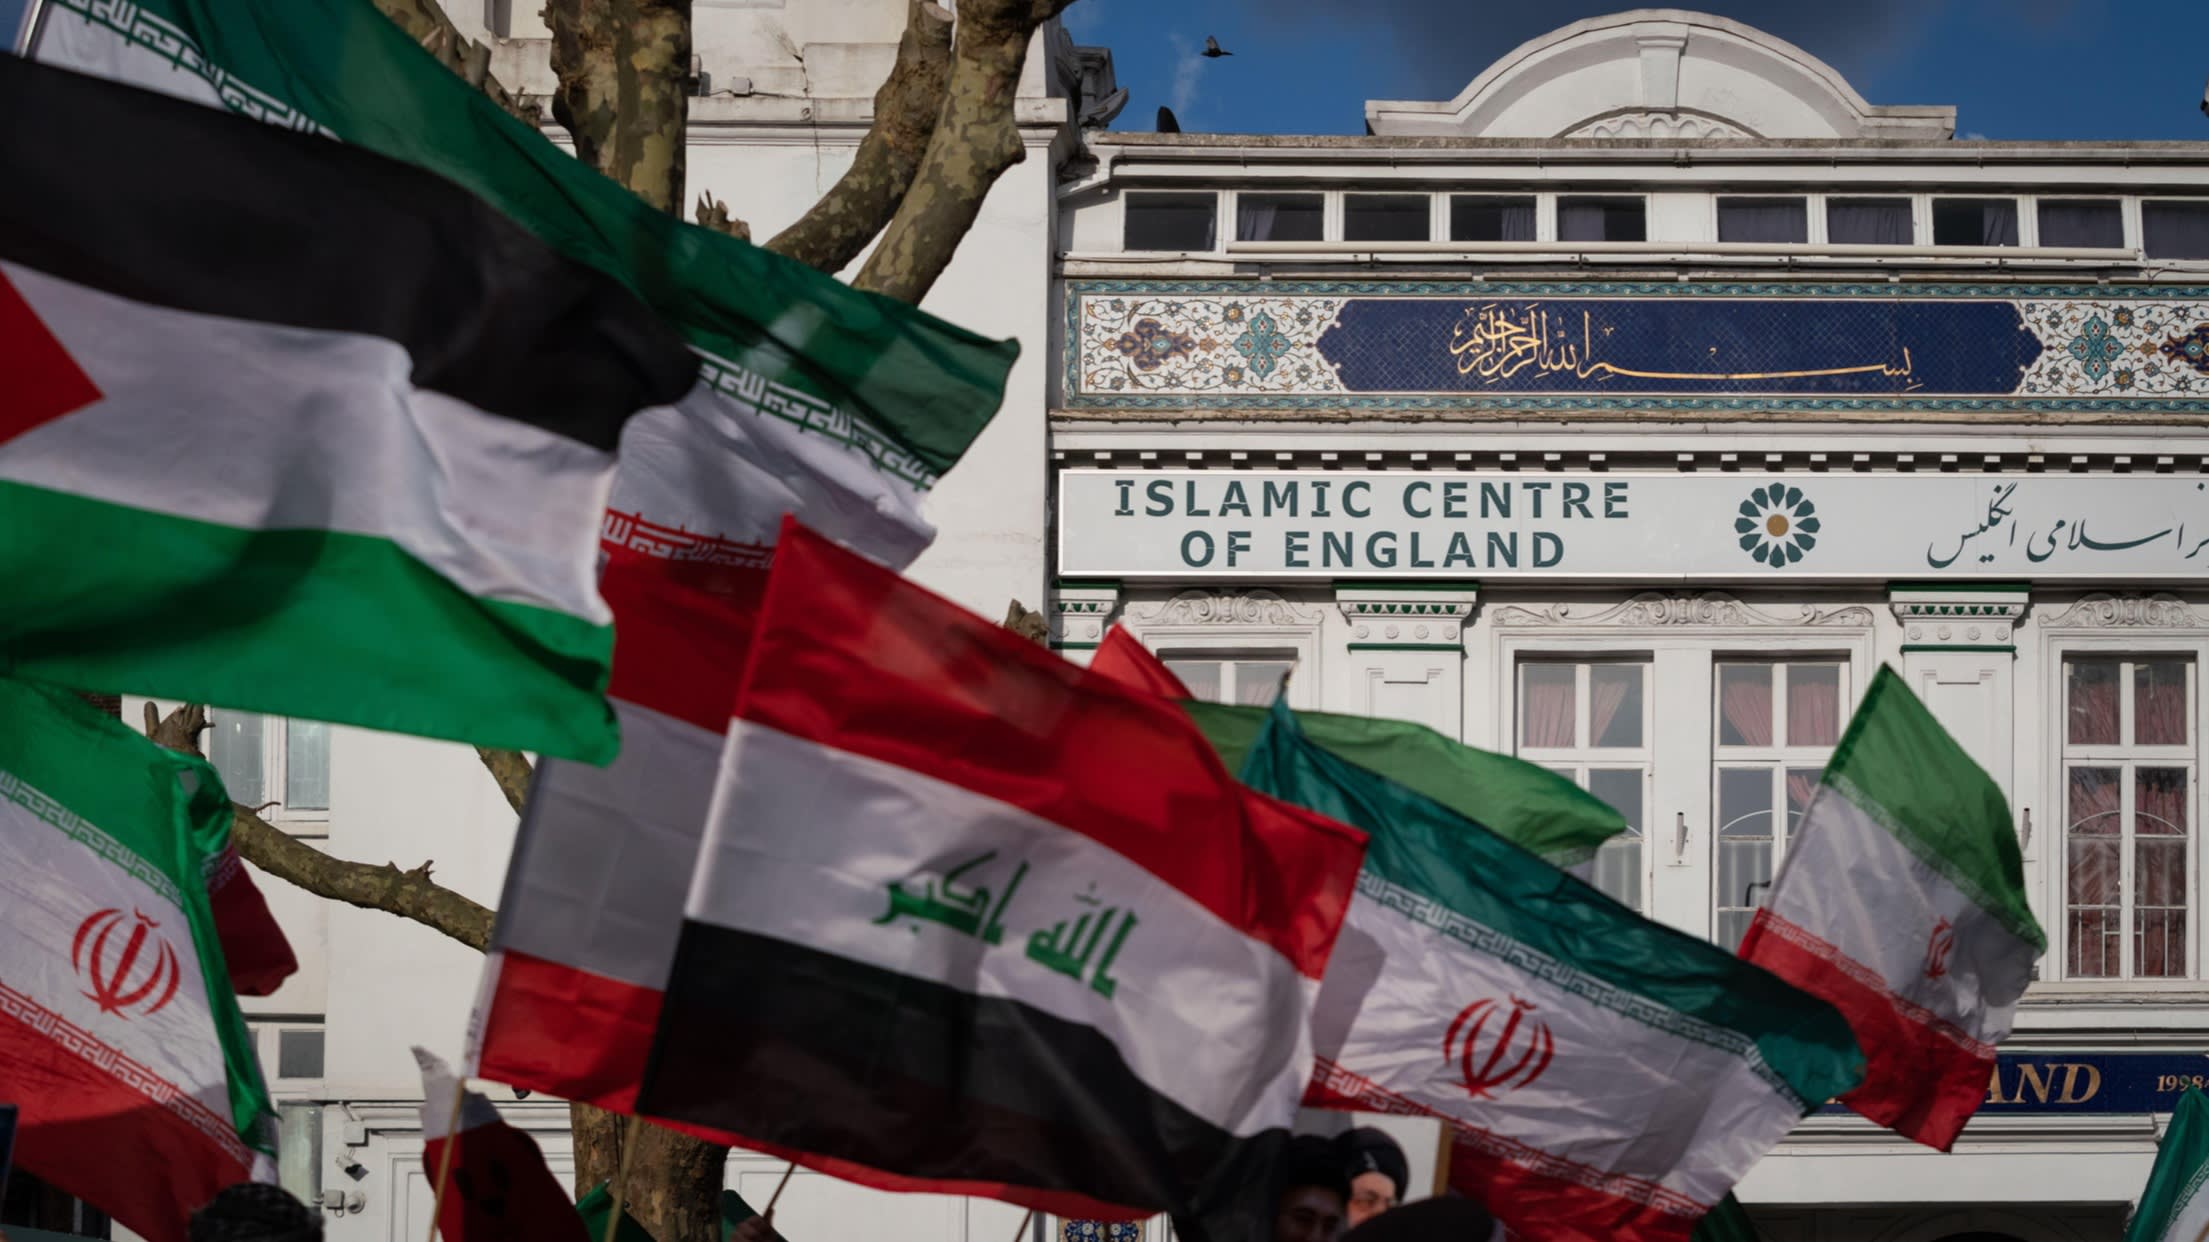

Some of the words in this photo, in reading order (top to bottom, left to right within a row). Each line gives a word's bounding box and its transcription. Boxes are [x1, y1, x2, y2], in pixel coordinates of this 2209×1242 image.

[1114, 479, 1373, 519] ISLAMIC
[1402, 481, 1631, 520] CENTRE
[1180, 530, 1252, 569] OF
[1284, 531, 1565, 570] ENGLAND
[1985, 1062, 2102, 1104] AND
[2155, 1073, 2209, 1092] 1998
